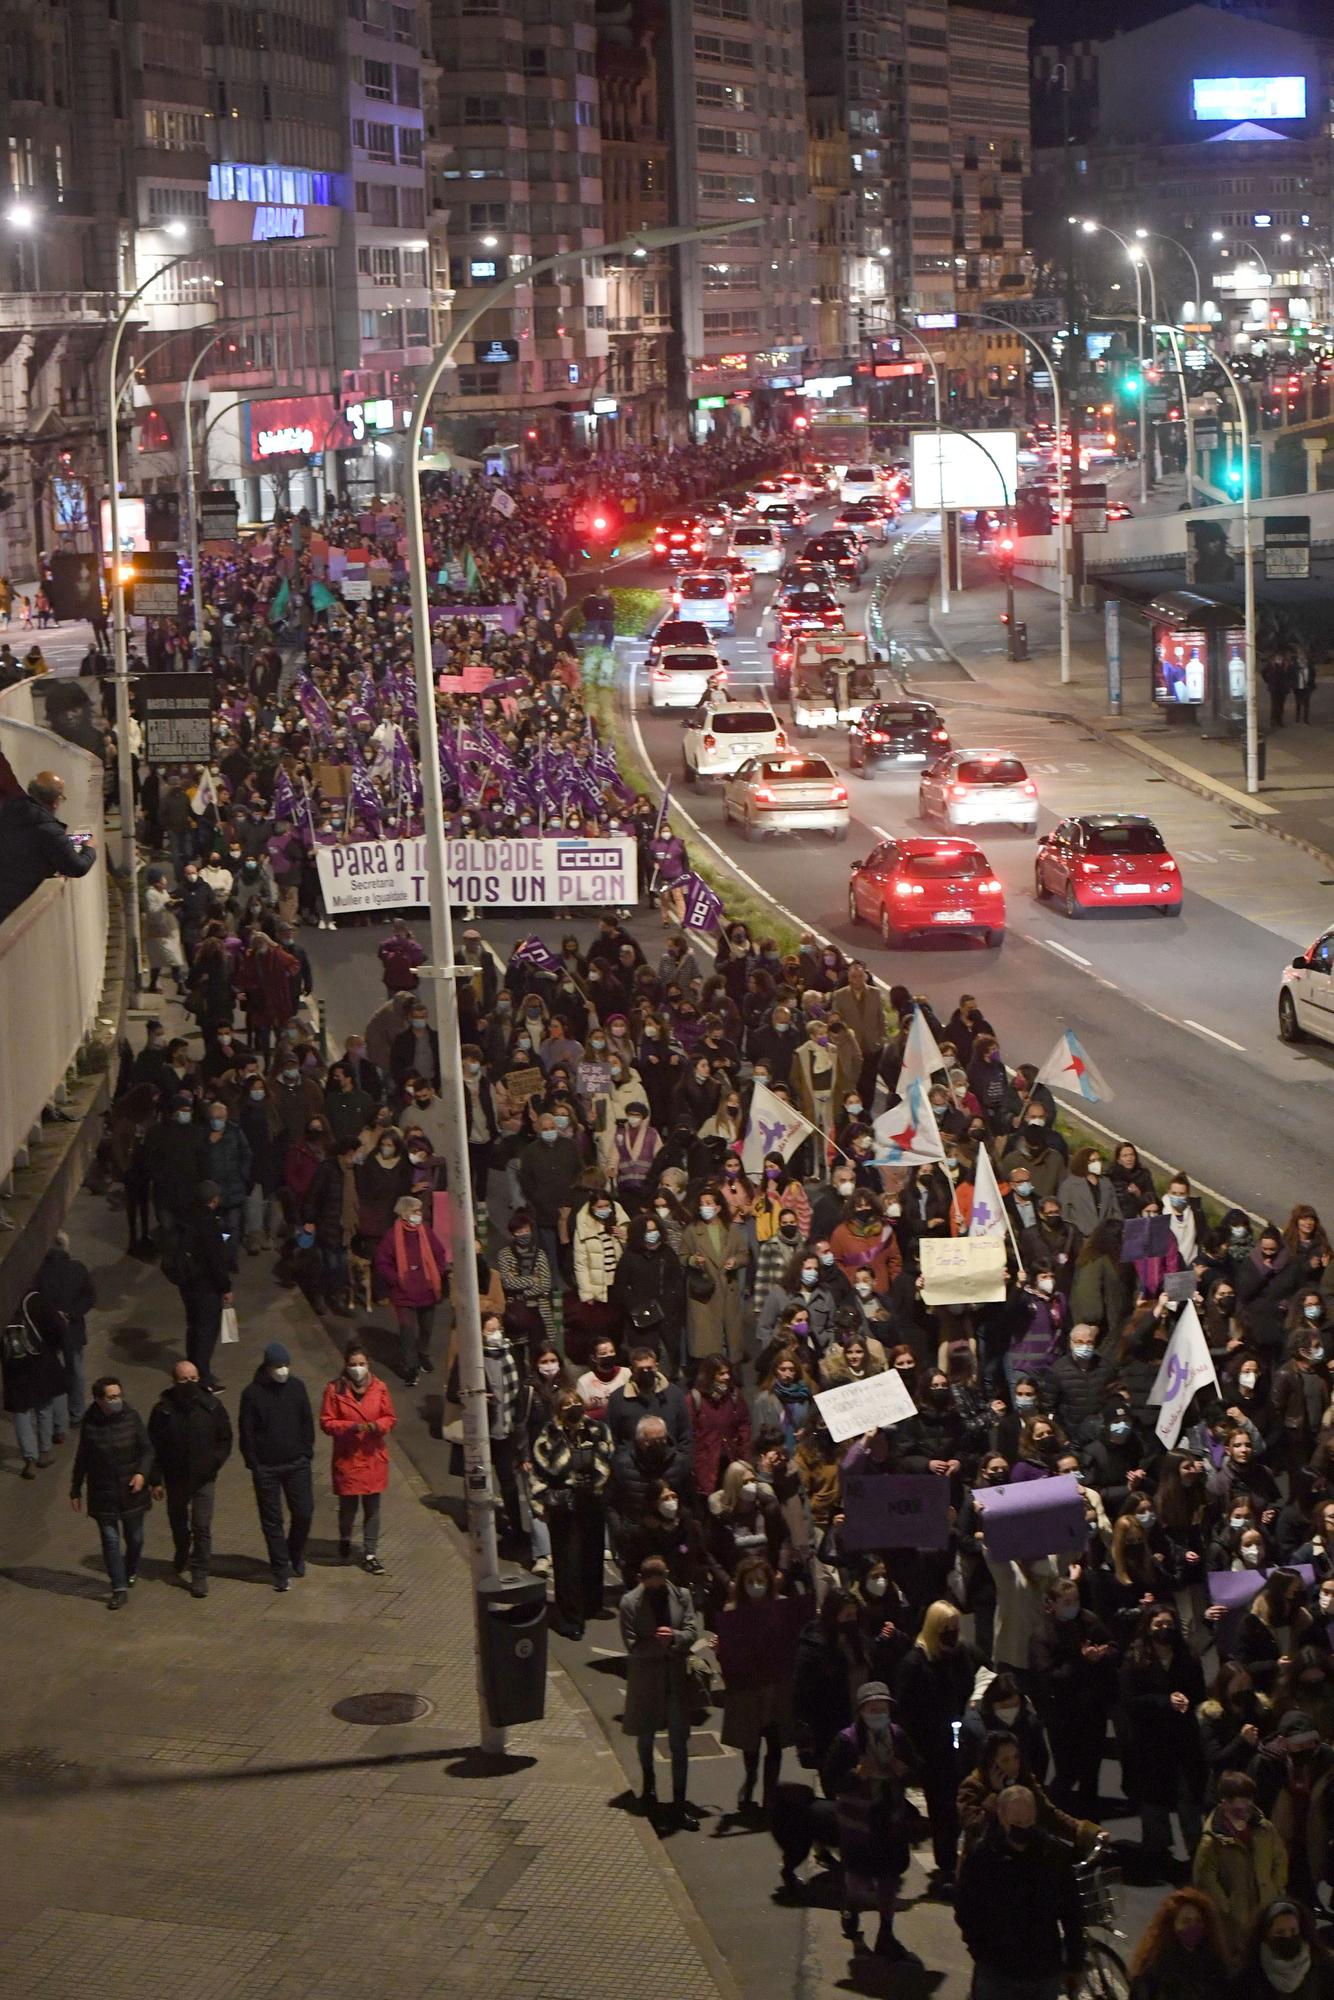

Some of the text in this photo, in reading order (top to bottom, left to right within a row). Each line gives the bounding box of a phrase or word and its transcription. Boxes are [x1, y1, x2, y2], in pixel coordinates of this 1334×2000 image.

[560, 851, 621, 868] CCOO
[411, 876, 499, 902] TMOS
[512, 876, 546, 902] UN
[332, 893, 362, 907] Muller
